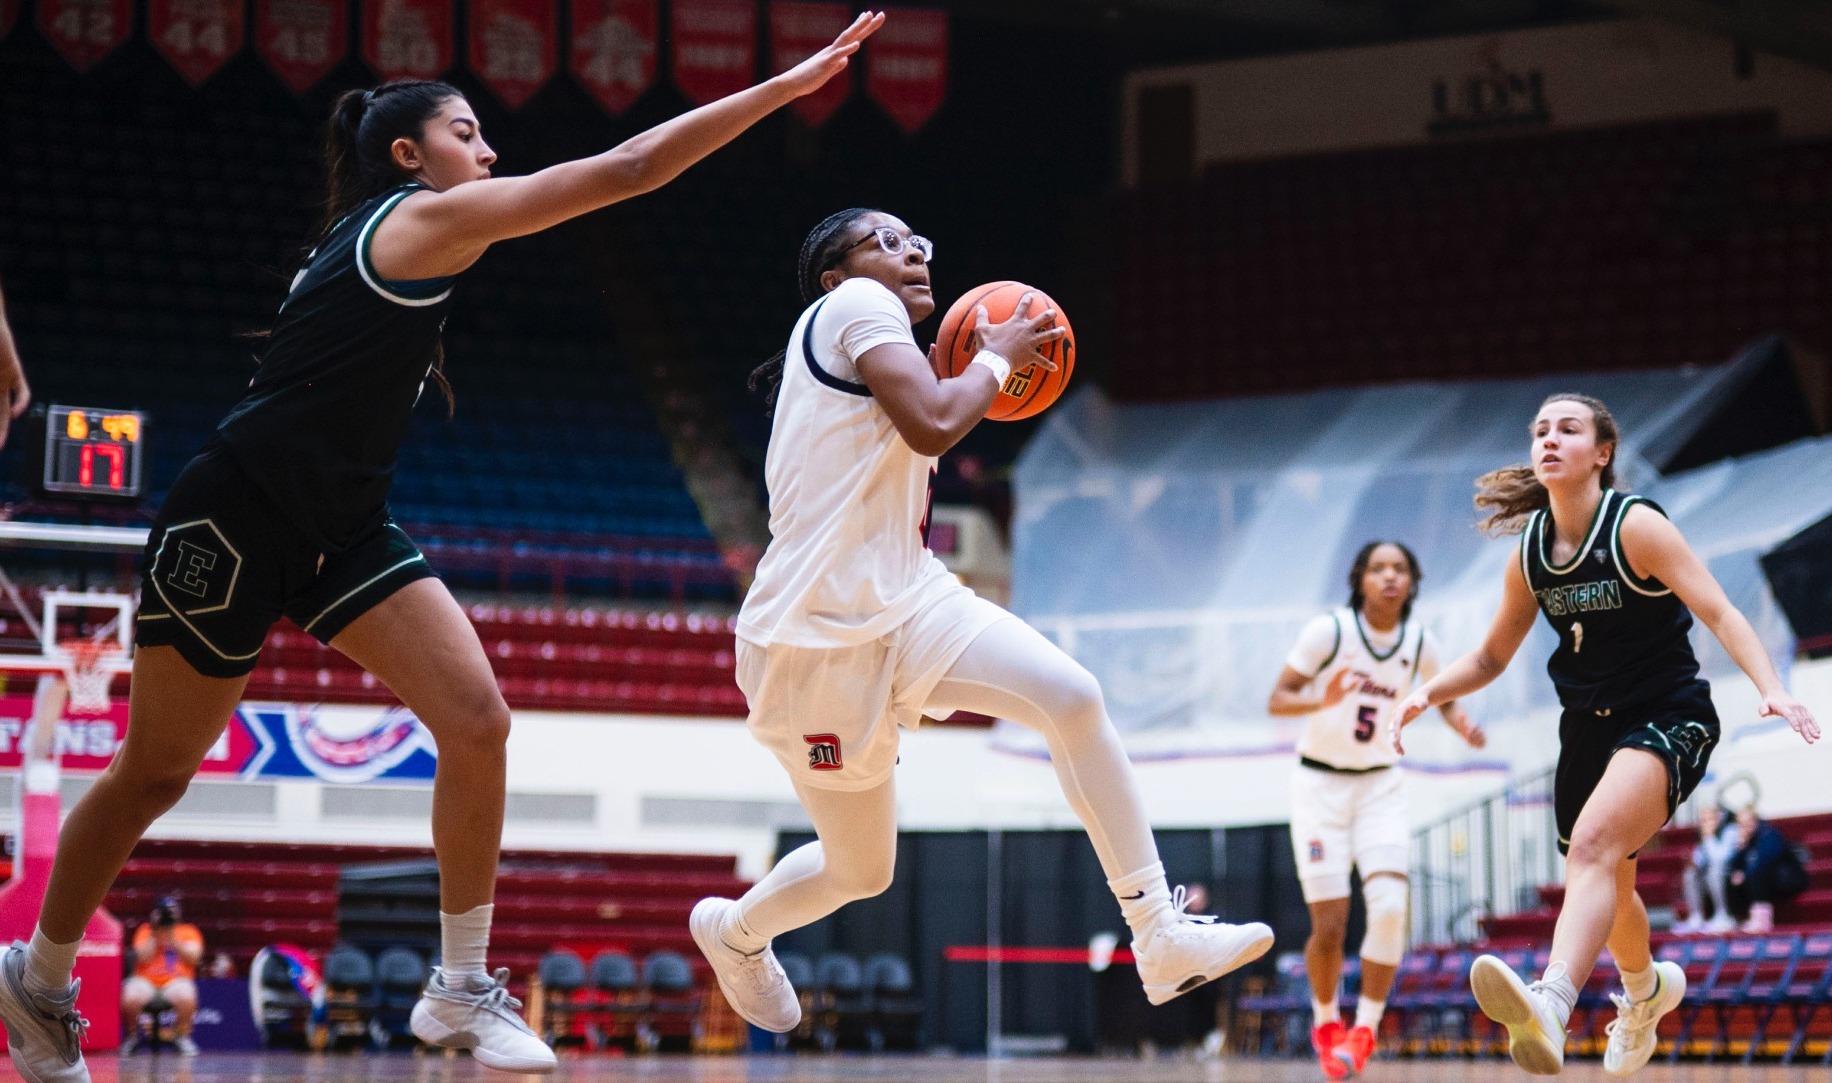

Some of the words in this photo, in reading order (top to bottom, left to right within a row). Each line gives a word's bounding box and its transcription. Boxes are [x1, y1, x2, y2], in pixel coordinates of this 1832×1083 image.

[79, 443, 124, 490] 17
[167, 540, 217, 598] E
[1354, 704, 1377, 743] 5
